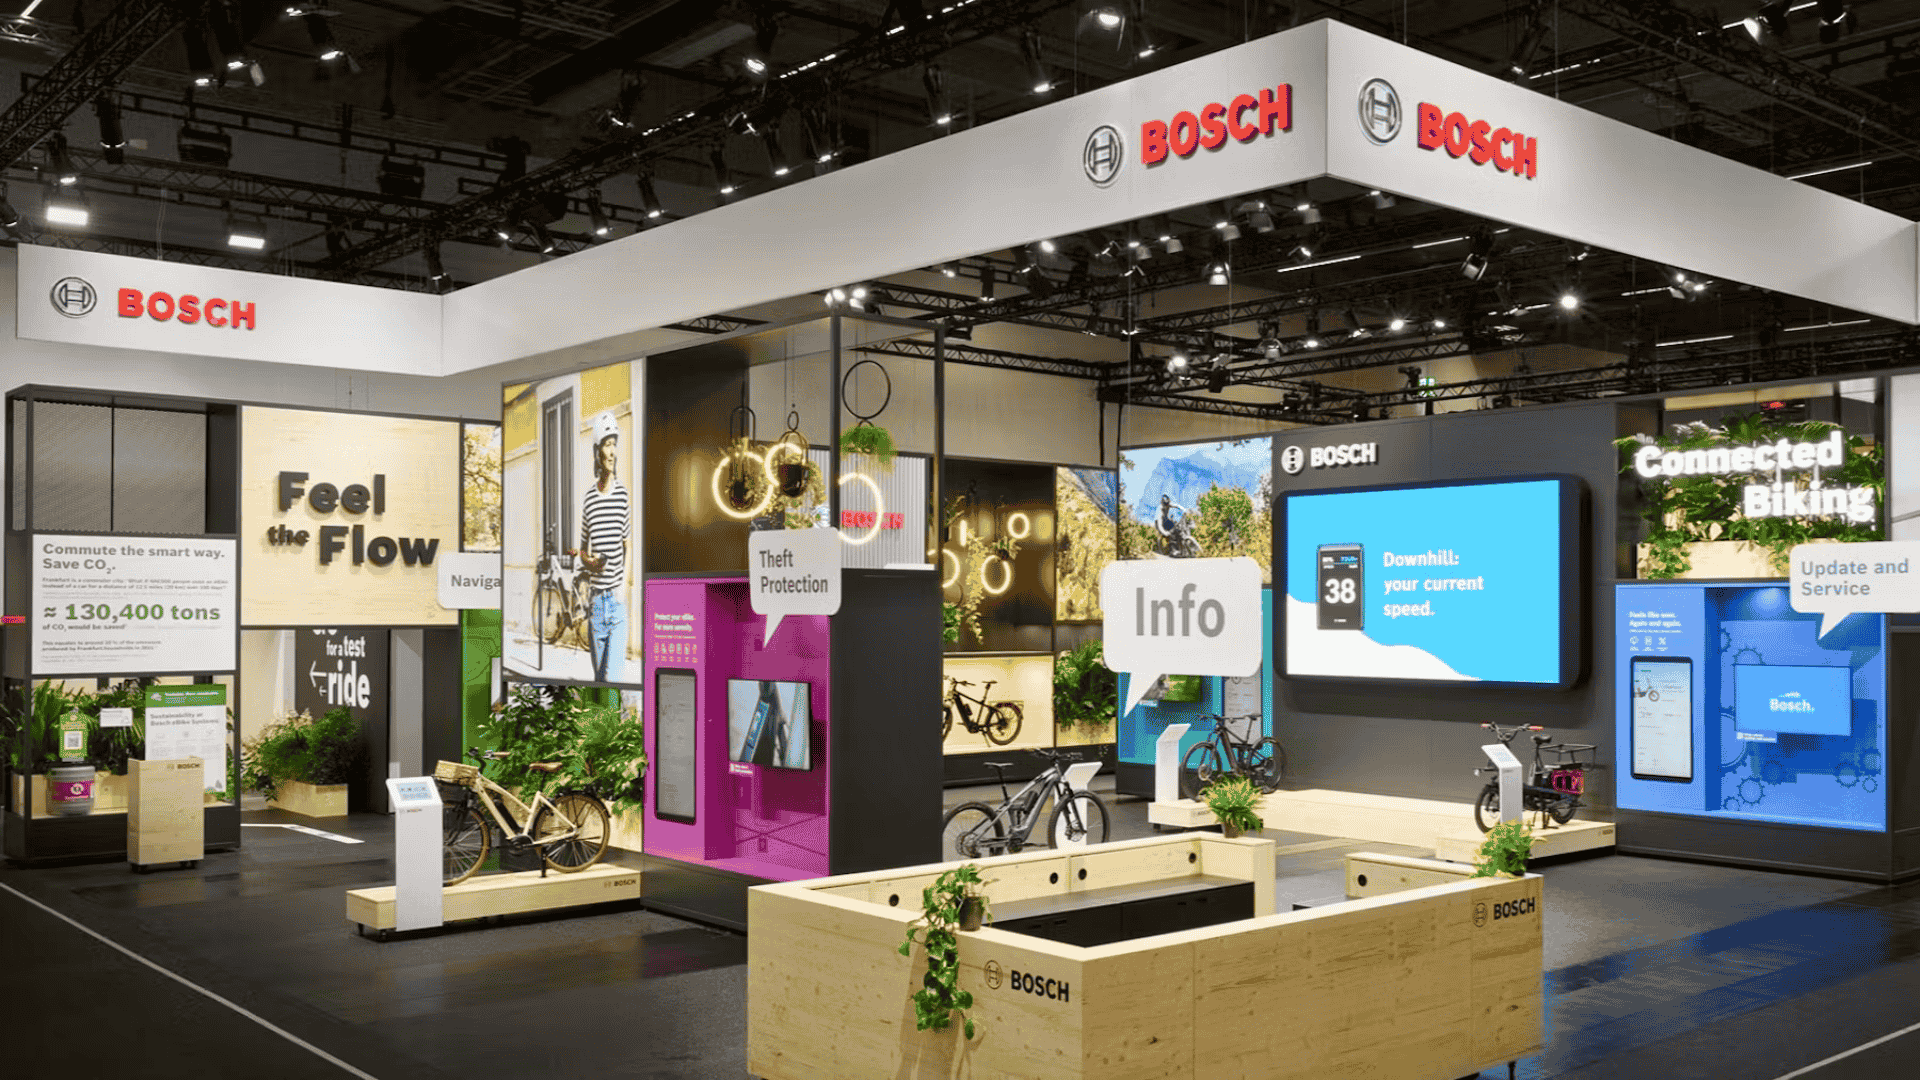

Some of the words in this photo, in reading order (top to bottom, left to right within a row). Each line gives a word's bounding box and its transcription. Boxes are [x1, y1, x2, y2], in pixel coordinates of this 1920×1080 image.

[1141, 83, 1292, 166] BOSCH
[1418, 101, 1537, 179] BOSCH
[117, 287, 256, 330] BOSCH
[1310, 443, 1377, 467] BOSCH
[1635, 430, 1843, 478] Connected
[278, 471, 386, 515] Feel
[1744, 480, 1875, 523] Biking
[43, 543, 117, 556] Commute
[121, 545, 145, 557] the
[148, 546, 191, 558] smart
[194, 548, 225, 560] way.
[267, 524, 310, 546] the
[319, 524, 440, 567] Flow
[43, 558, 80, 570] Save
[759, 549, 794, 568] Theft
[1383, 549, 1460, 567] Downhill:
[1801, 560, 1868, 578] Update
[1874, 558, 1909, 574] and
[451, 574, 502, 590] Naviga
[760, 574, 828, 593] Protection
[1325, 578, 1356, 604] 38
[1384, 578, 1419, 595] your
[1423, 576, 1485, 591] current
[1801, 581, 1871, 596] Service
[65, 603, 164, 624] 130,400
[171, 605, 221, 620] tons
[1136, 583, 1225, 638] Info
[1383, 600, 1436, 619] speed.
[326, 640, 337, 656] for
[338, 644, 343, 656] a
[343, 635, 366, 658] test
[328, 659, 371, 709] ride
[1769, 698, 1816, 713] Bosch.
[614, 878, 637, 887] BOSCH
[1493, 897, 1536, 921] BOSCH
[1010, 970, 1070, 1003] BOSCH
